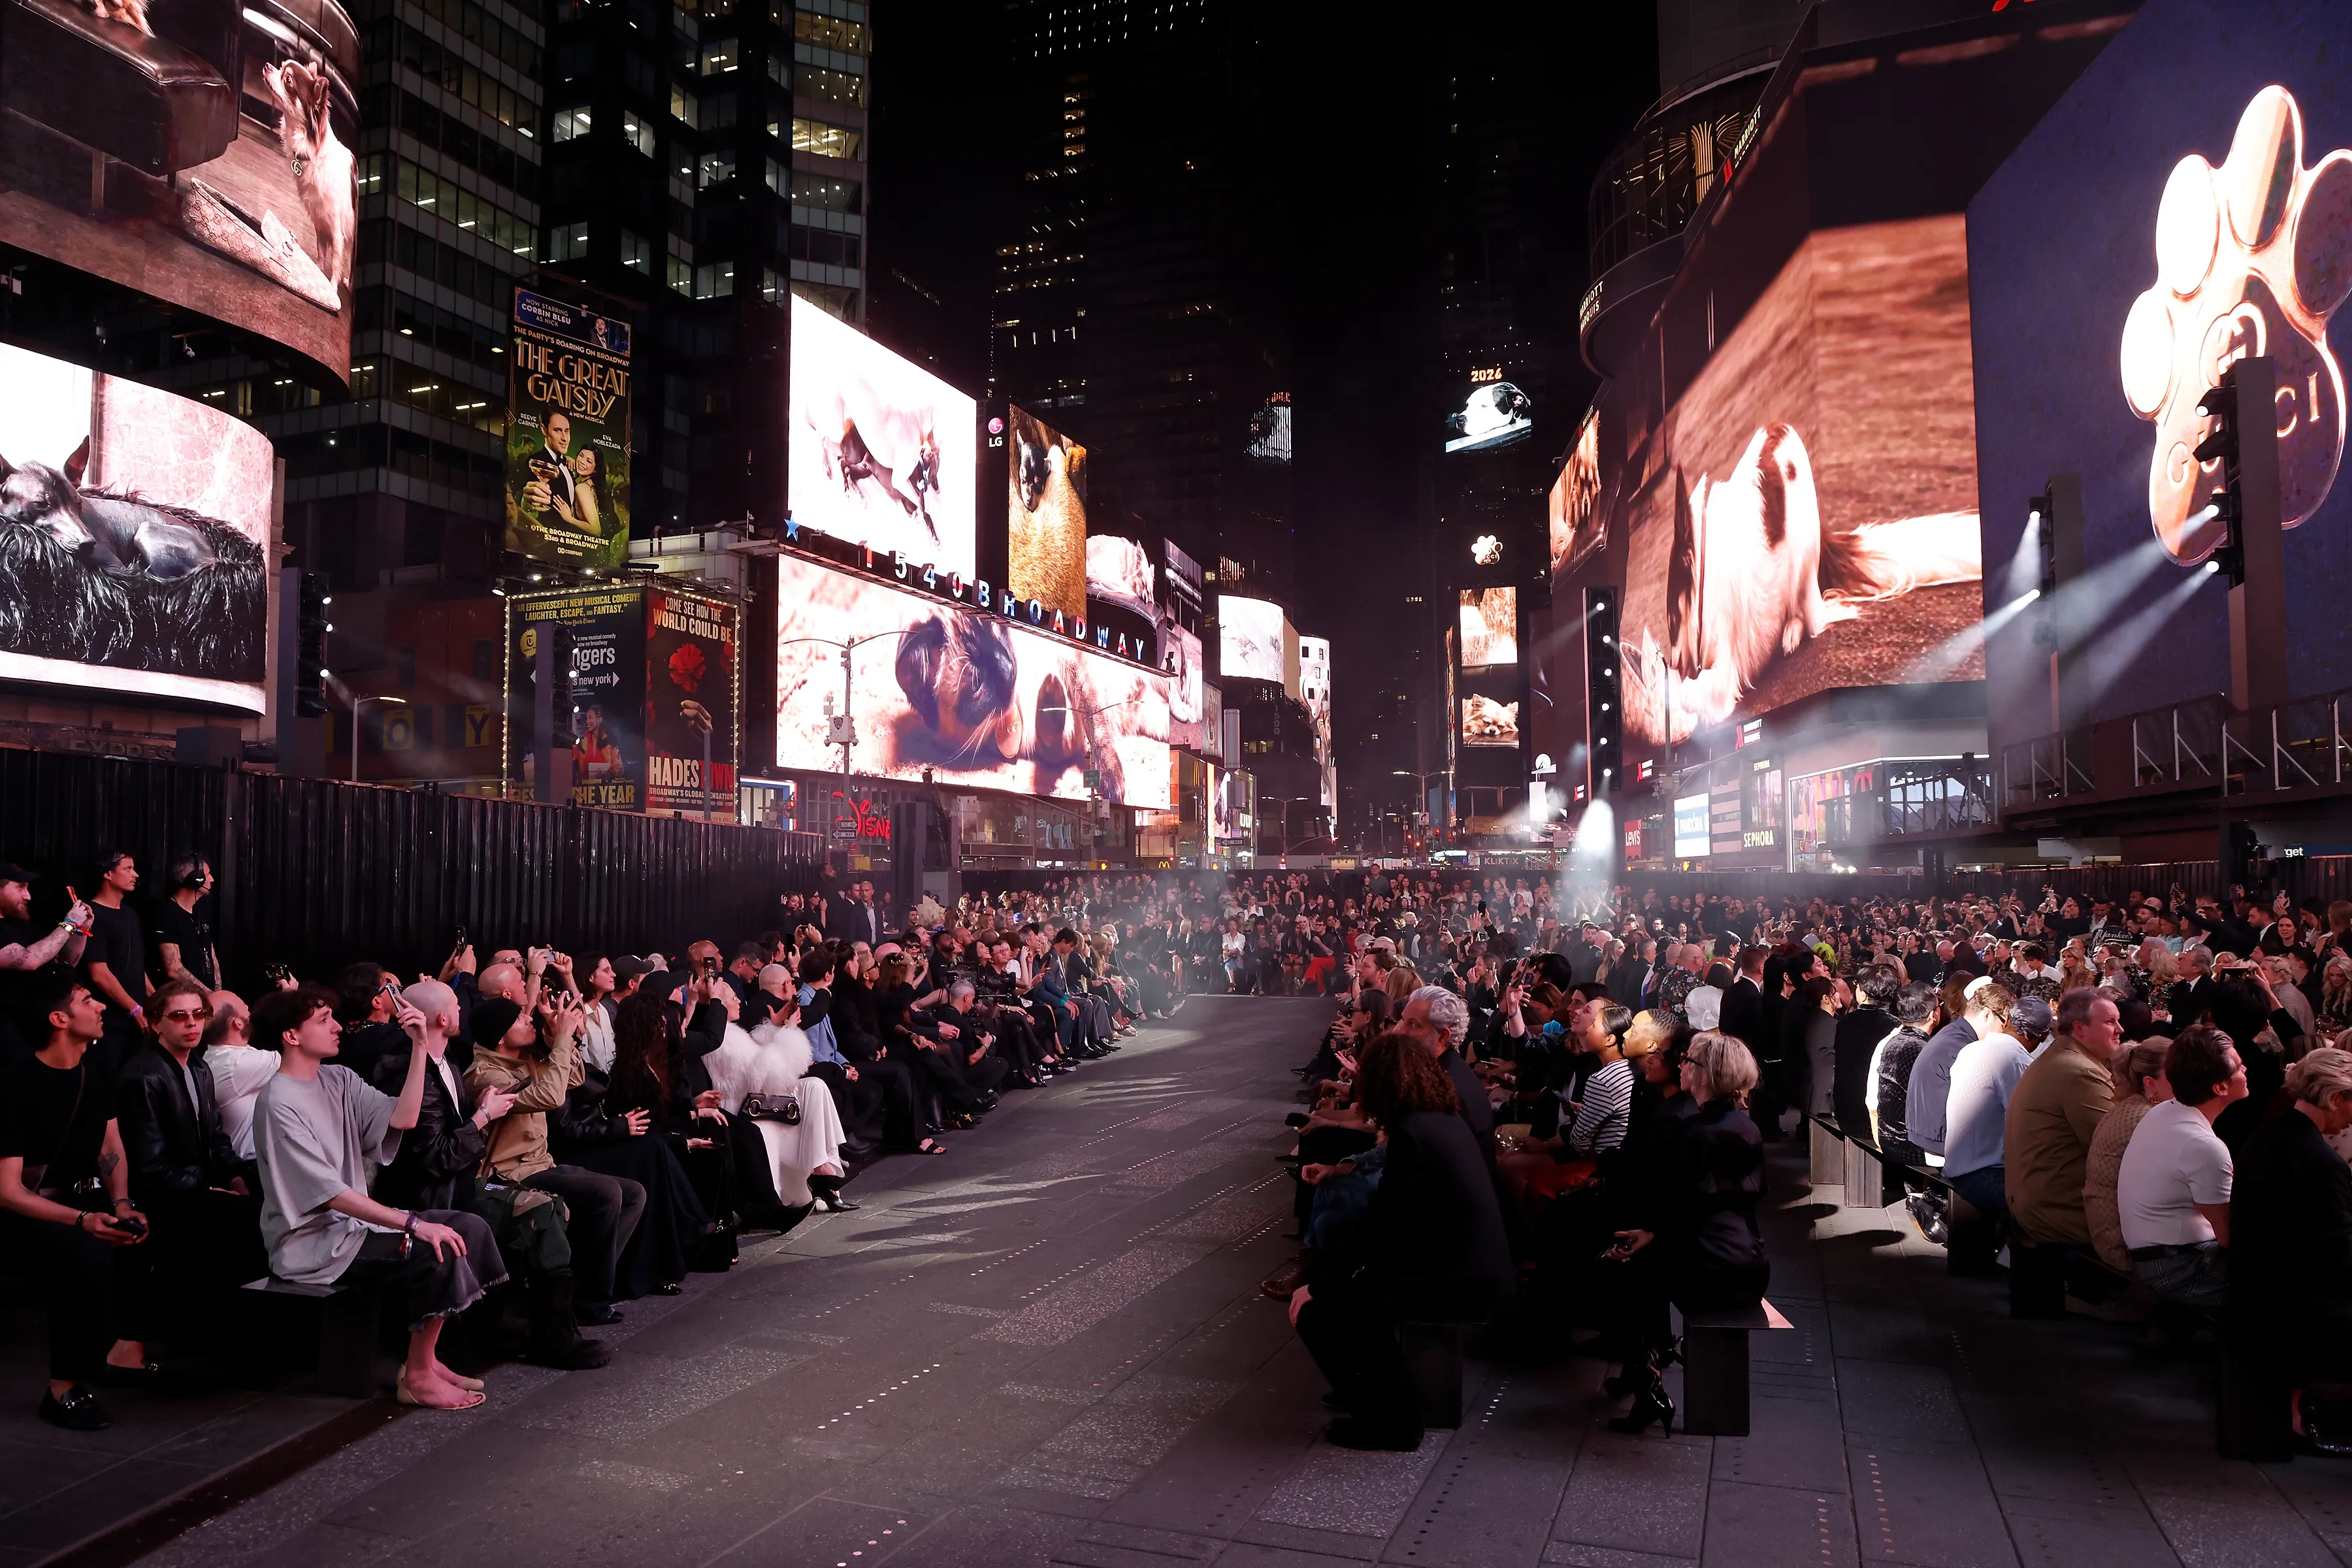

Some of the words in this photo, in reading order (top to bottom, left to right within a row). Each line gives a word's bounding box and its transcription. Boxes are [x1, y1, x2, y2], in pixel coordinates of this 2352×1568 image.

[1734, 104, 1761, 160] MARRIOTT
[526, 298, 540, 307] NOW
[542, 301, 568, 316] STARRING
[1579, 280, 1603, 320] MARRIOTT
[521, 303, 551, 318] CORBIN
[553, 314, 571, 325] BLEU
[544, 318, 559, 327] NICK
[1580, 300, 1599, 335] MARQUIS
[514, 325, 527, 335] THE
[528, 331, 555, 344] PARTY'S
[556, 338, 585, 353] ROARING
[596, 351, 630, 367] BROADWAY
[515, 340, 553, 376] THE
[559, 354, 629, 397] GREAT
[1471, 367, 1503, 382] 2026
[527, 373, 615, 418] GATSBY
[518, 419, 539, 429] CARNEY
[520, 413, 537, 422] REEVE
[585, 416, 605, 425] MUSICAL
[593, 438, 621, 450] NOBLEZADA
[988, 436, 1003, 448] LG
[536, 525, 548, 534] THE
[549, 528, 583, 540] BROADWAY
[583, 535, 610, 546] THEATRE
[544, 534, 559, 542] 53RD
[565, 538, 598, 549] BROADWAY
[525, 599, 569, 612] EFFERVESCENT
[569, 598, 584, 607] NEW
[584, 595, 612, 606] MUSICAL
[612, 593, 640, 604] COMEDY!
[665, 596, 682, 613] COME
[683, 600, 694, 616] SEE
[696, 604, 709, 619] HOW
[710, 607, 722, 623] THE
[860, 543, 964, 598] 1540
[977, 579, 1144, 661] BROADWAY
[525, 610, 559, 621] LAUGHTER,
[560, 608, 585, 618] ESCAPE,
[653, 608, 687, 632] WORLD
[689, 617, 719, 640] COULD
[579, 676, 593, 686] new
[595, 673, 612, 687] york
[599, 785, 635, 804] YEAR
[649, 787, 684, 797] BROADWAY'S
[685, 790, 704, 798] GLOBAL
[1744, 830, 1774, 848] SEPHORA
